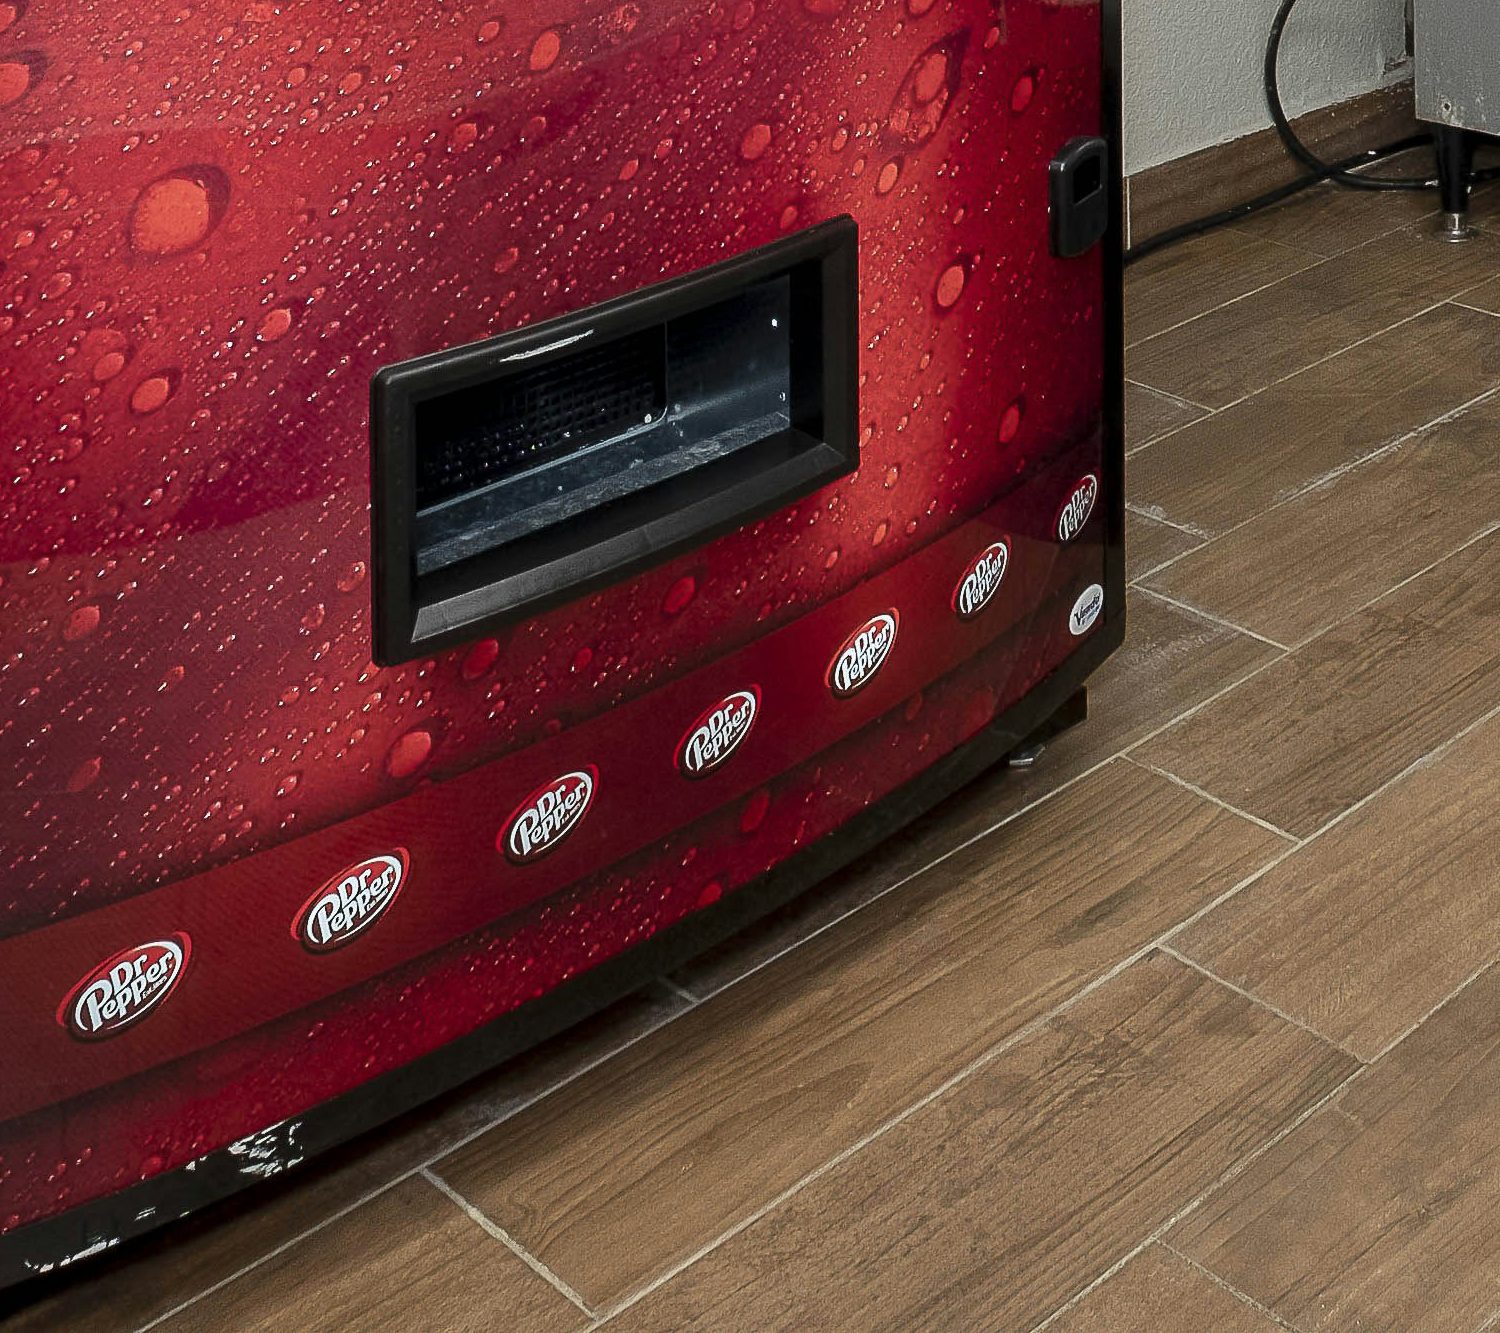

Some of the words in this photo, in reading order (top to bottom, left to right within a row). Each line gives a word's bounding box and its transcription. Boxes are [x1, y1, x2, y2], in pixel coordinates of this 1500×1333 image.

[834, 622, 890, 690] Pepper
[854, 625, 877, 656] Dr
[685, 700, 750, 771] Pepper
[708, 703, 734, 739] Dr
[510, 781, 586, 856] Pepper
[536, 784, 566, 823] Dr
[307, 865, 394, 944] Pepper
[337, 868, 372, 909] Dr
[75, 951, 174, 1032] Pepper
[109, 954, 148, 996] Dr
